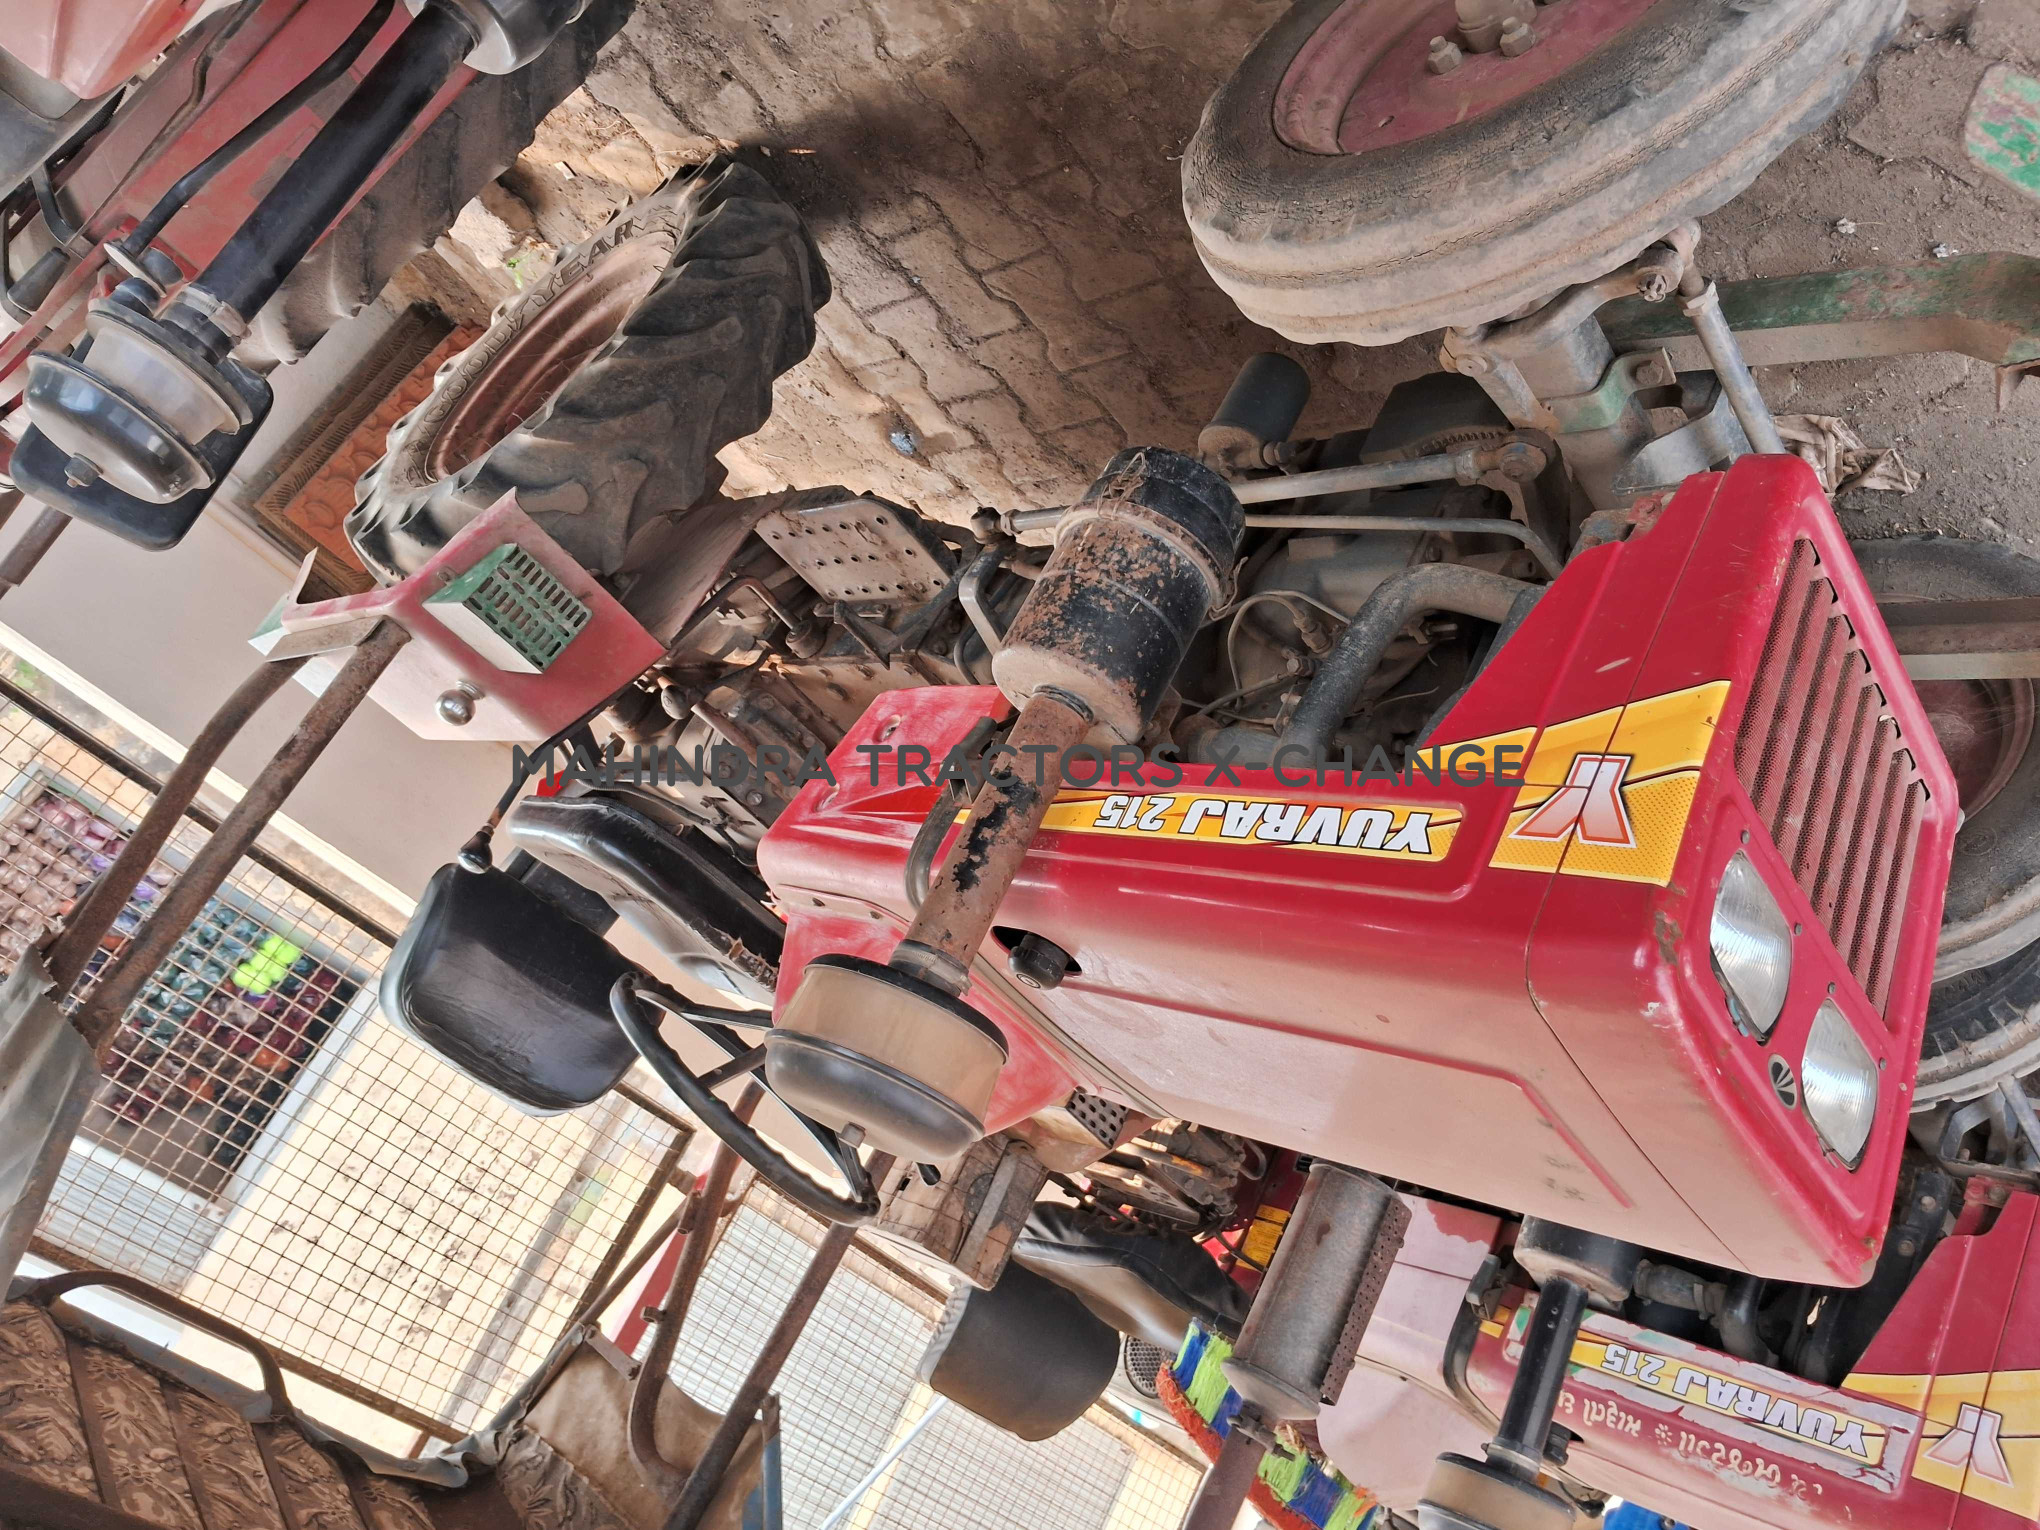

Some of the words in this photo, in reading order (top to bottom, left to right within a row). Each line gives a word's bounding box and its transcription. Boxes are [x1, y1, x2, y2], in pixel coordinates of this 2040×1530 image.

[1093, 793, 1176, 832] 215
[1177, 798, 1434, 855] YUVRAJ
[1600, 1343, 1667, 1385] 215
[1671, 1366, 1869, 1458] YUVRAJ
